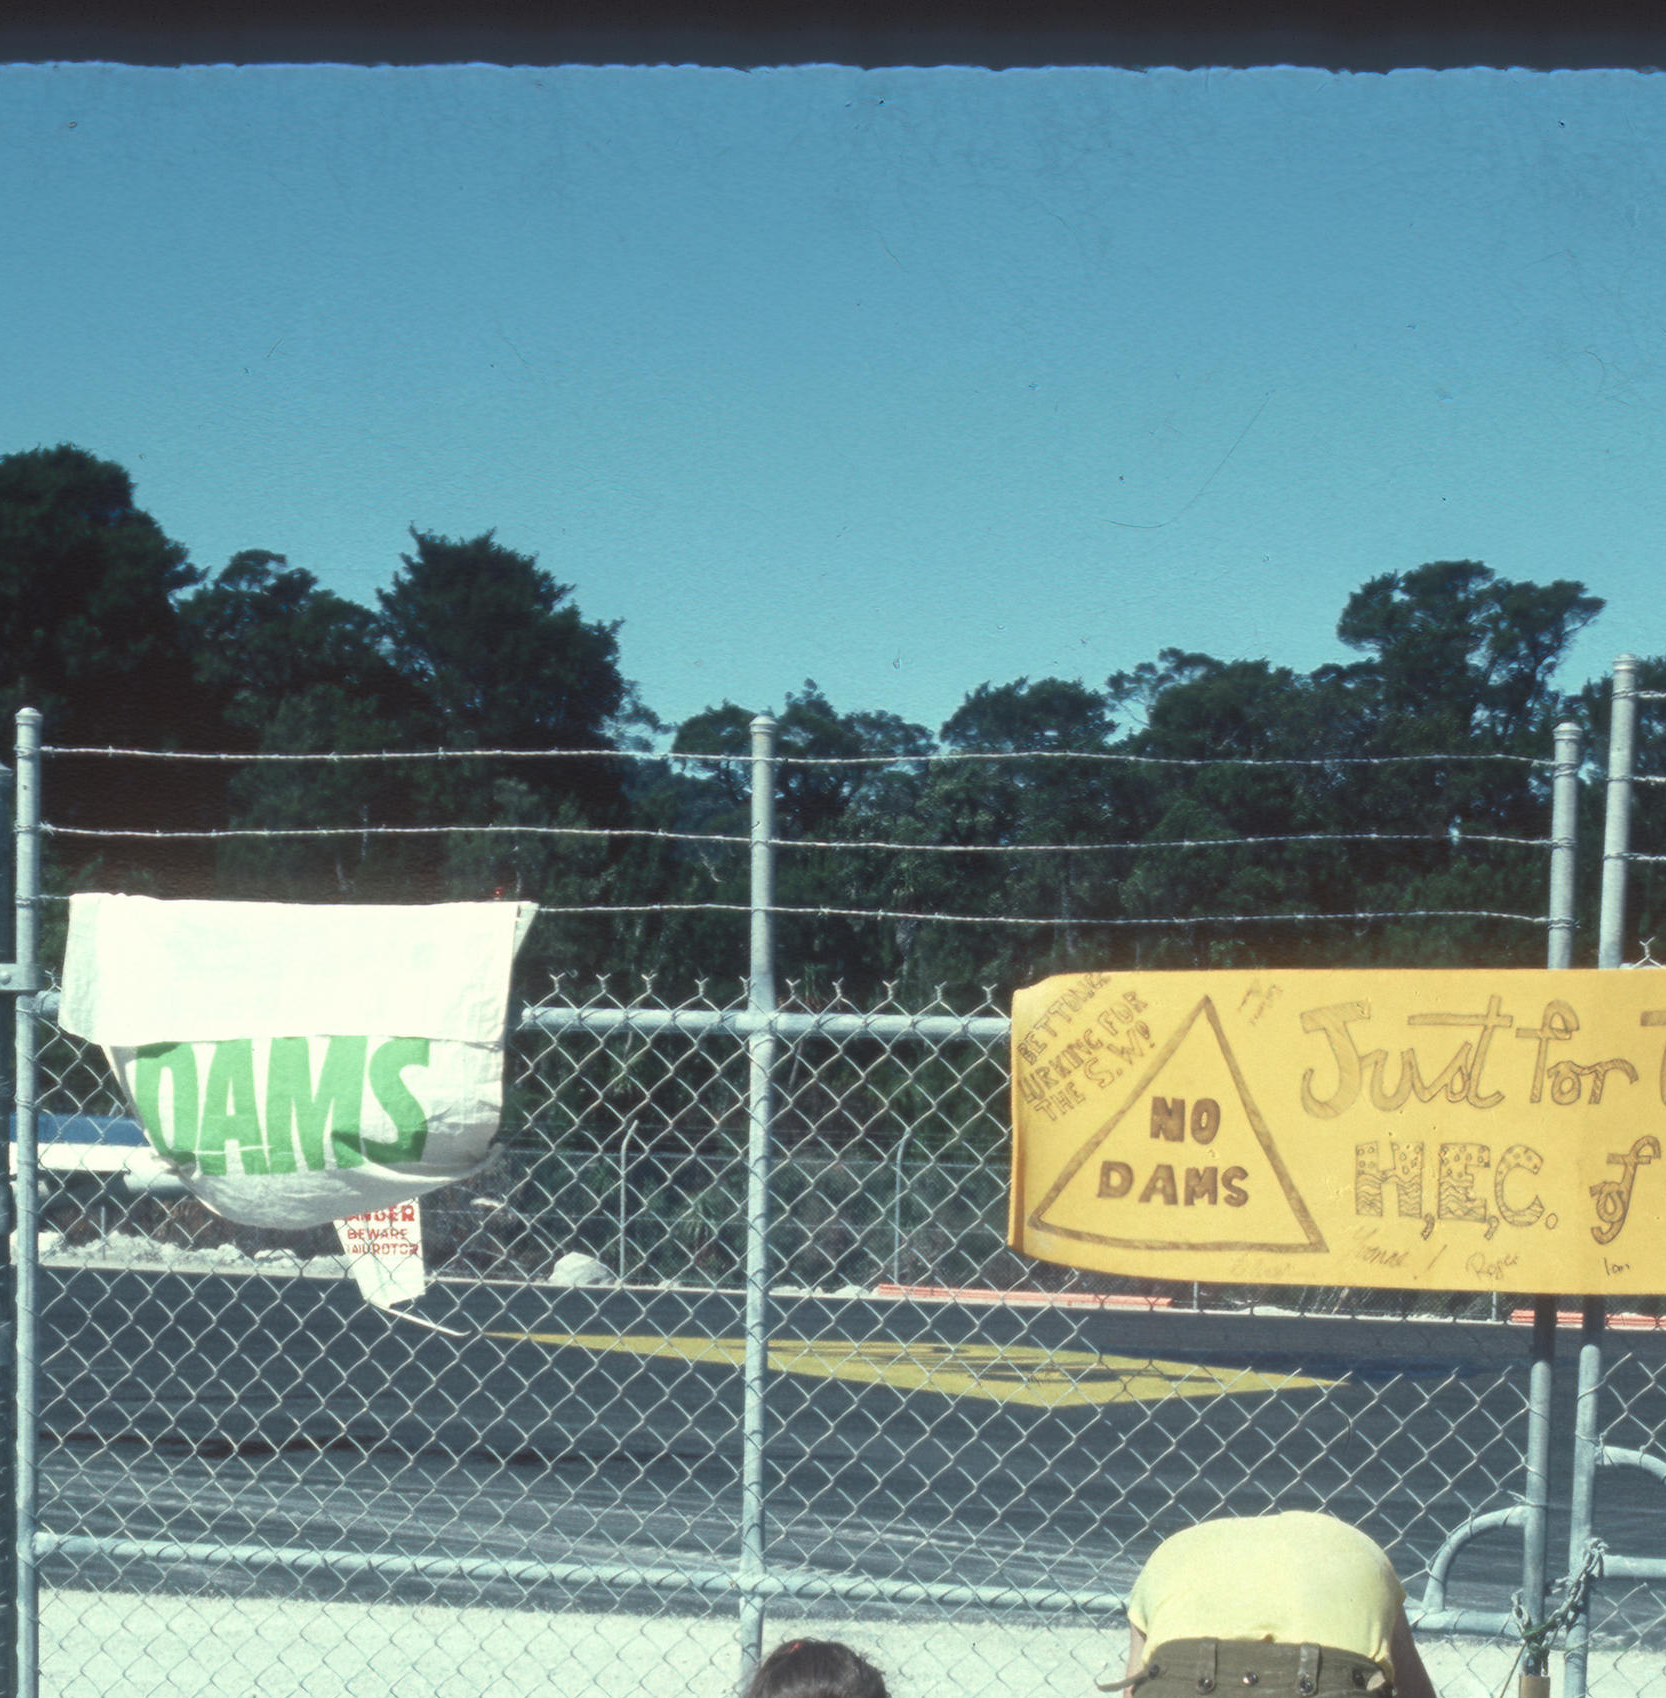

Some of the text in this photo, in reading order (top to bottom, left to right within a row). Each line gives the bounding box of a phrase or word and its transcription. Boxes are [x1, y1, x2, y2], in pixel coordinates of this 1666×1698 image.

[1300, 994, 1513, 1120] Just
[1516, 1000, 1639, 1106] for
[132, 1034, 430, 1177] DAMS
[1034, 1081, 1086, 1121] THE
[1150, 1096, 1221, 1146] NO
[1096, 1159, 1250, 1209] DAMS
[1589, 1135, 1662, 1246] of
[347, 1228, 408, 1241] BEWARE
